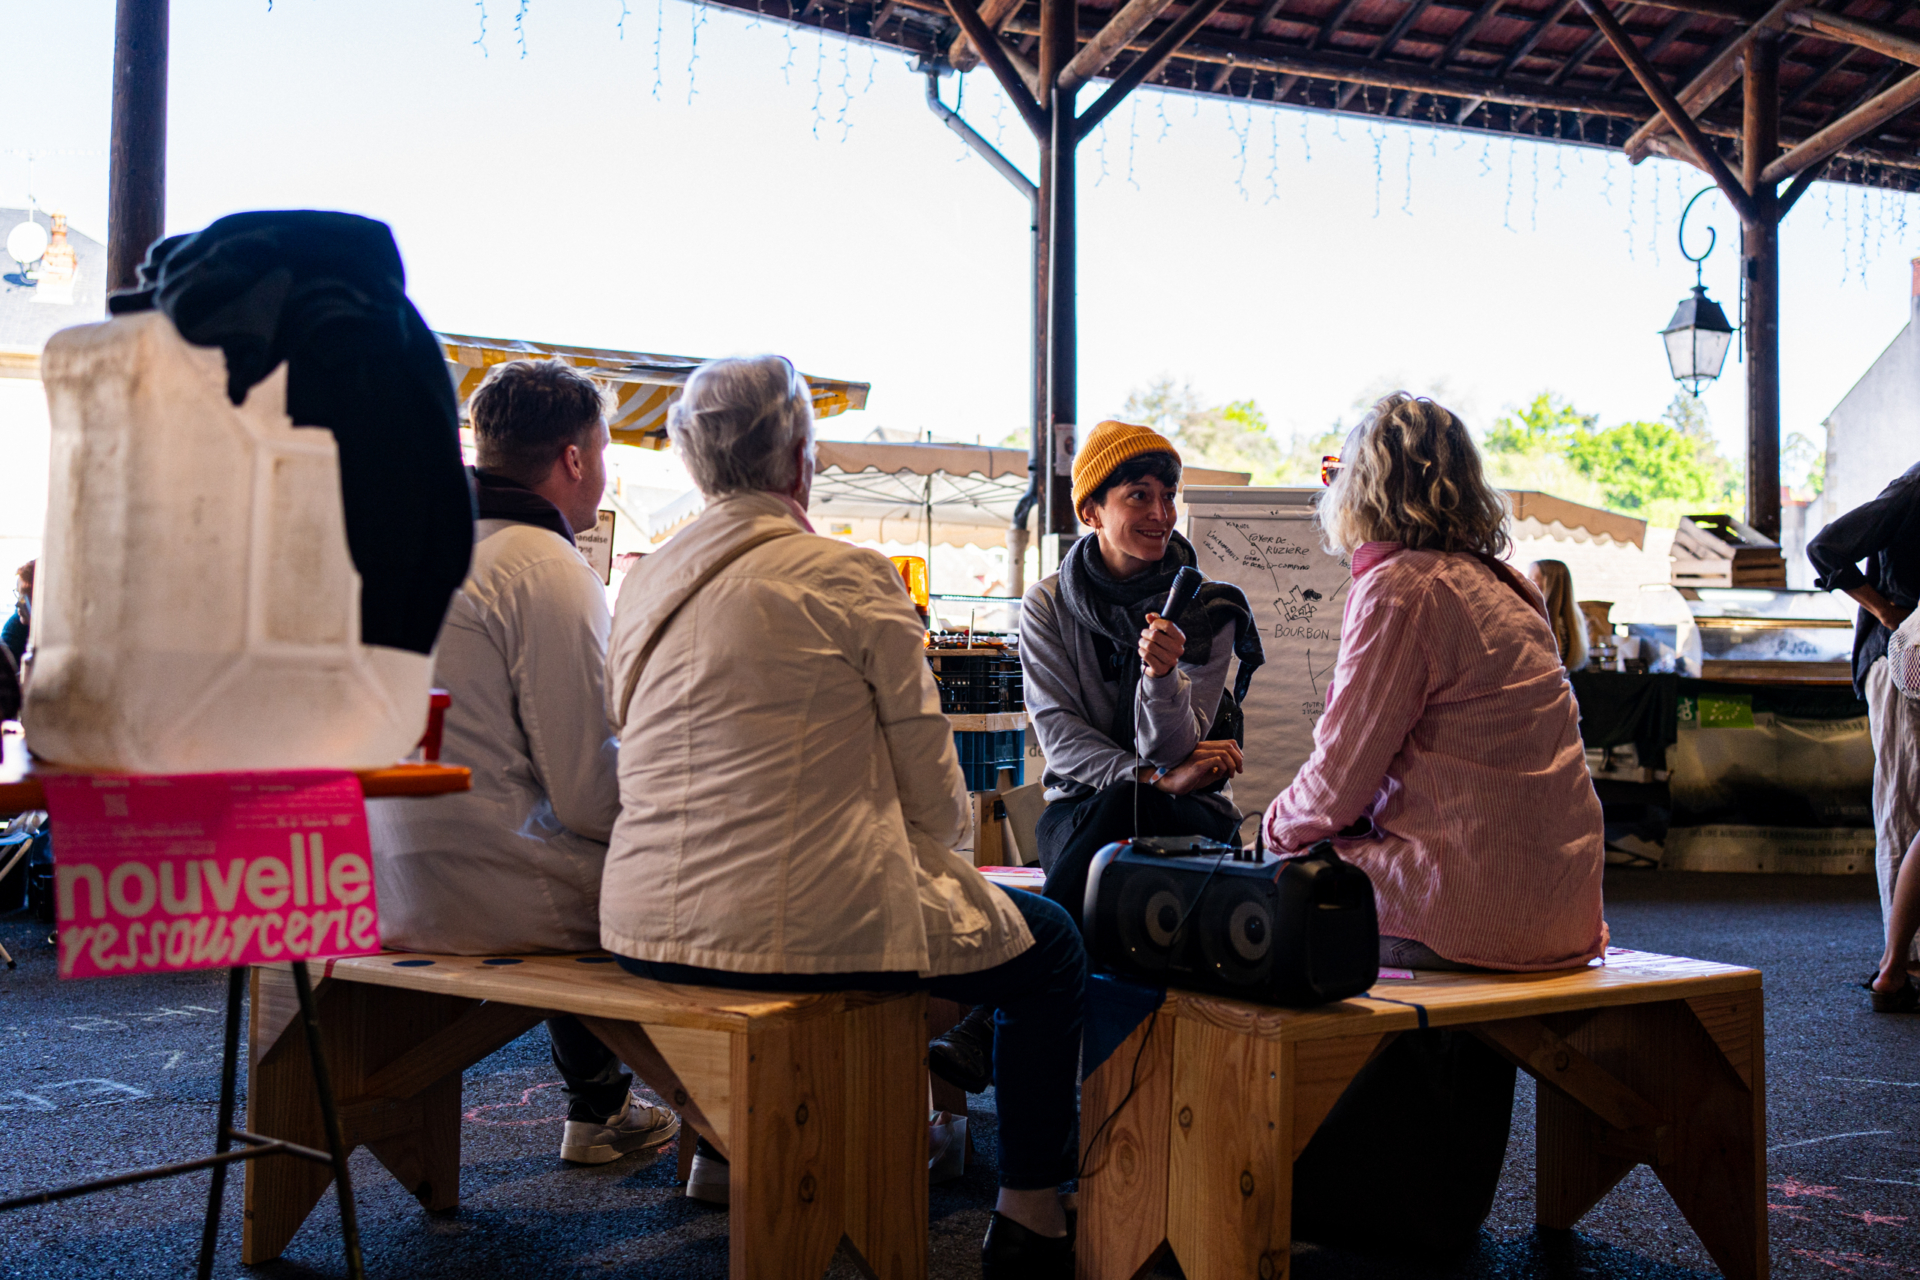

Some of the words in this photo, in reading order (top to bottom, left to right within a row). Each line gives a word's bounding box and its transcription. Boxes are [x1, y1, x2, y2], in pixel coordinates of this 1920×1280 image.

[1274, 623, 1330, 641] BOURBON
[58, 832, 371, 921] nouvelle
[62, 901, 376, 974] ressourcerie
